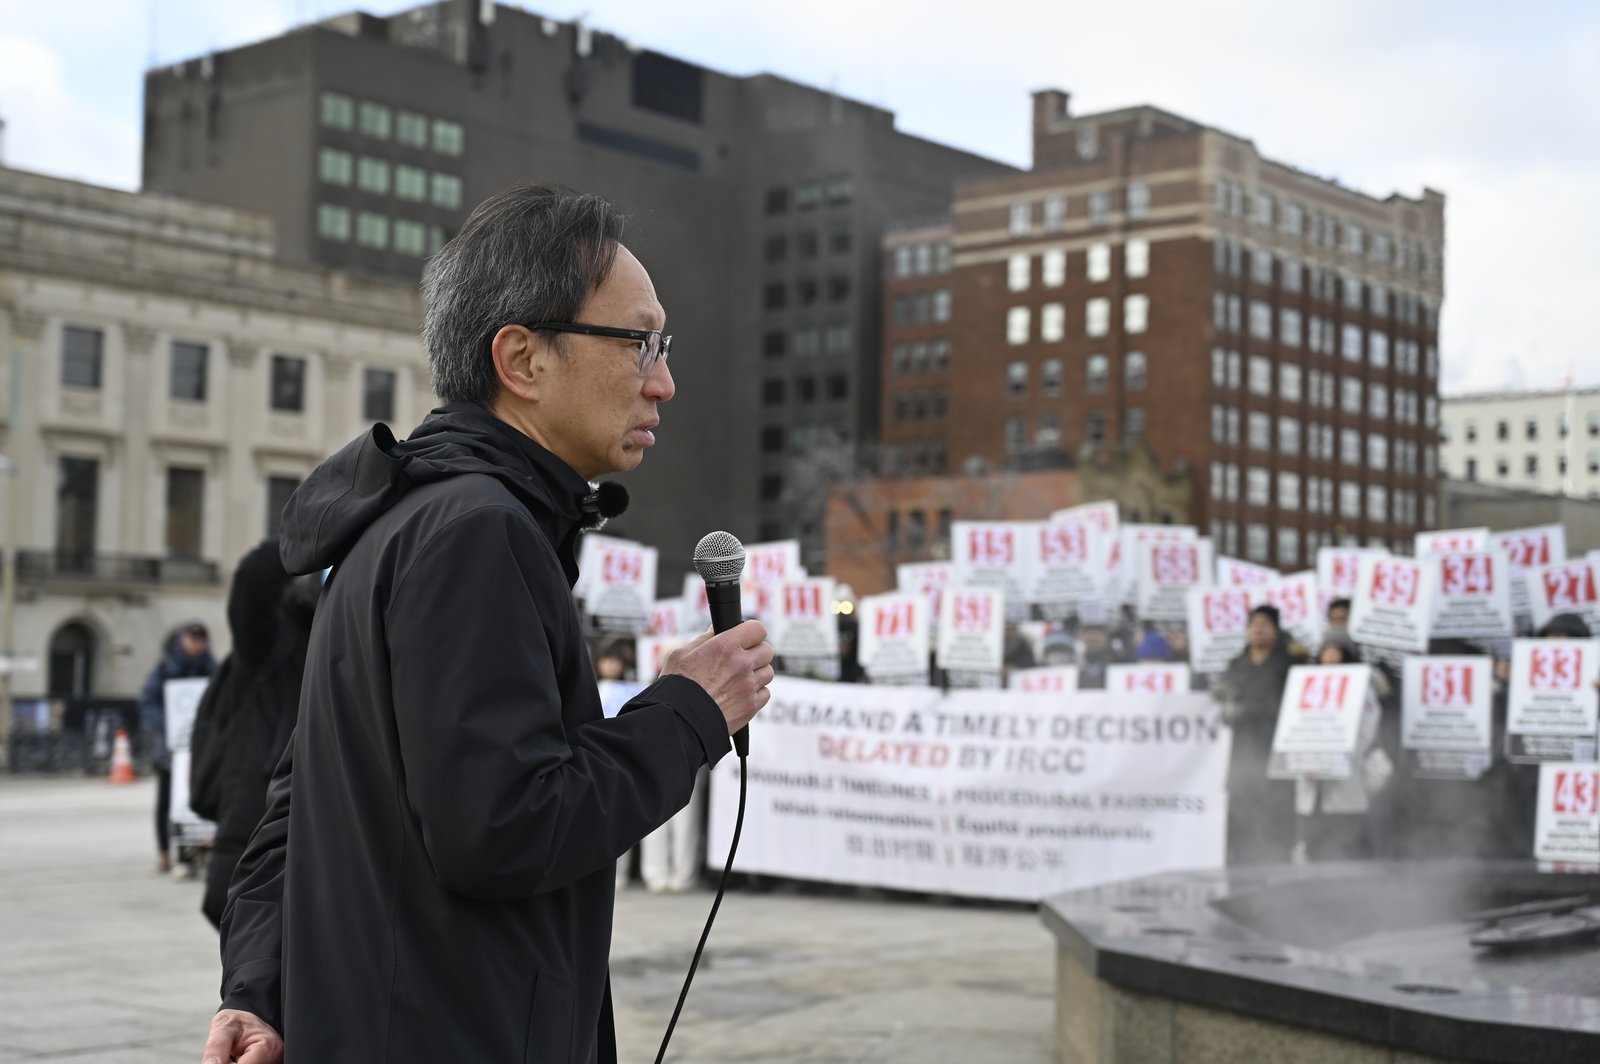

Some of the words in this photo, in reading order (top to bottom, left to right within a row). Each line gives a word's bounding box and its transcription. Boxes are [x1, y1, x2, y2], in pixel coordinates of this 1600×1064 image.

[1370, 562, 1419, 606] 39
[1441, 555, 1492, 594] 34
[1544, 565, 1597, 608] 27
[1422, 665, 1473, 705] 81
[1530, 648, 1583, 690] 33
[1299, 674, 1350, 710] 41
[771, 702, 895, 732] DEMAND
[903, 712, 925, 735] A
[936, 713, 1042, 740] TIMELY
[1050, 714, 1220, 744] DECISION
[818, 734, 950, 769] DELAYED
[959, 746, 997, 771] BY
[1005, 746, 1086, 776] IRCC
[1554, 771, 1599, 814] 43
